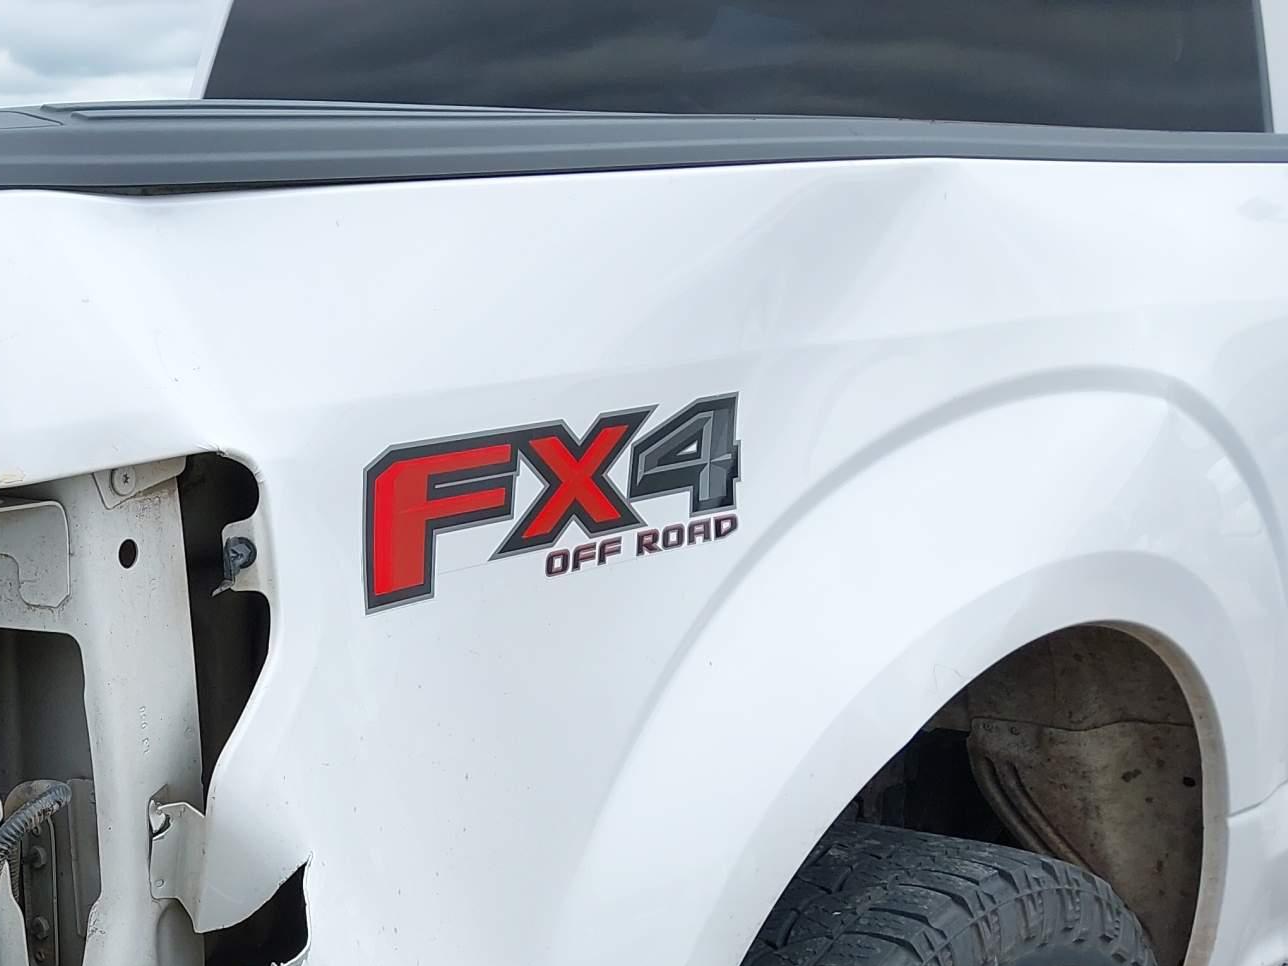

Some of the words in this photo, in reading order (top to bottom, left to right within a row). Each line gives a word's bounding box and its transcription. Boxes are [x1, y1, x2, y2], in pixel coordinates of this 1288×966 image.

[363, 391, 741, 616] FX4
[545, 536, 622, 577] OFF
[636, 514, 738, 556] ROAD
